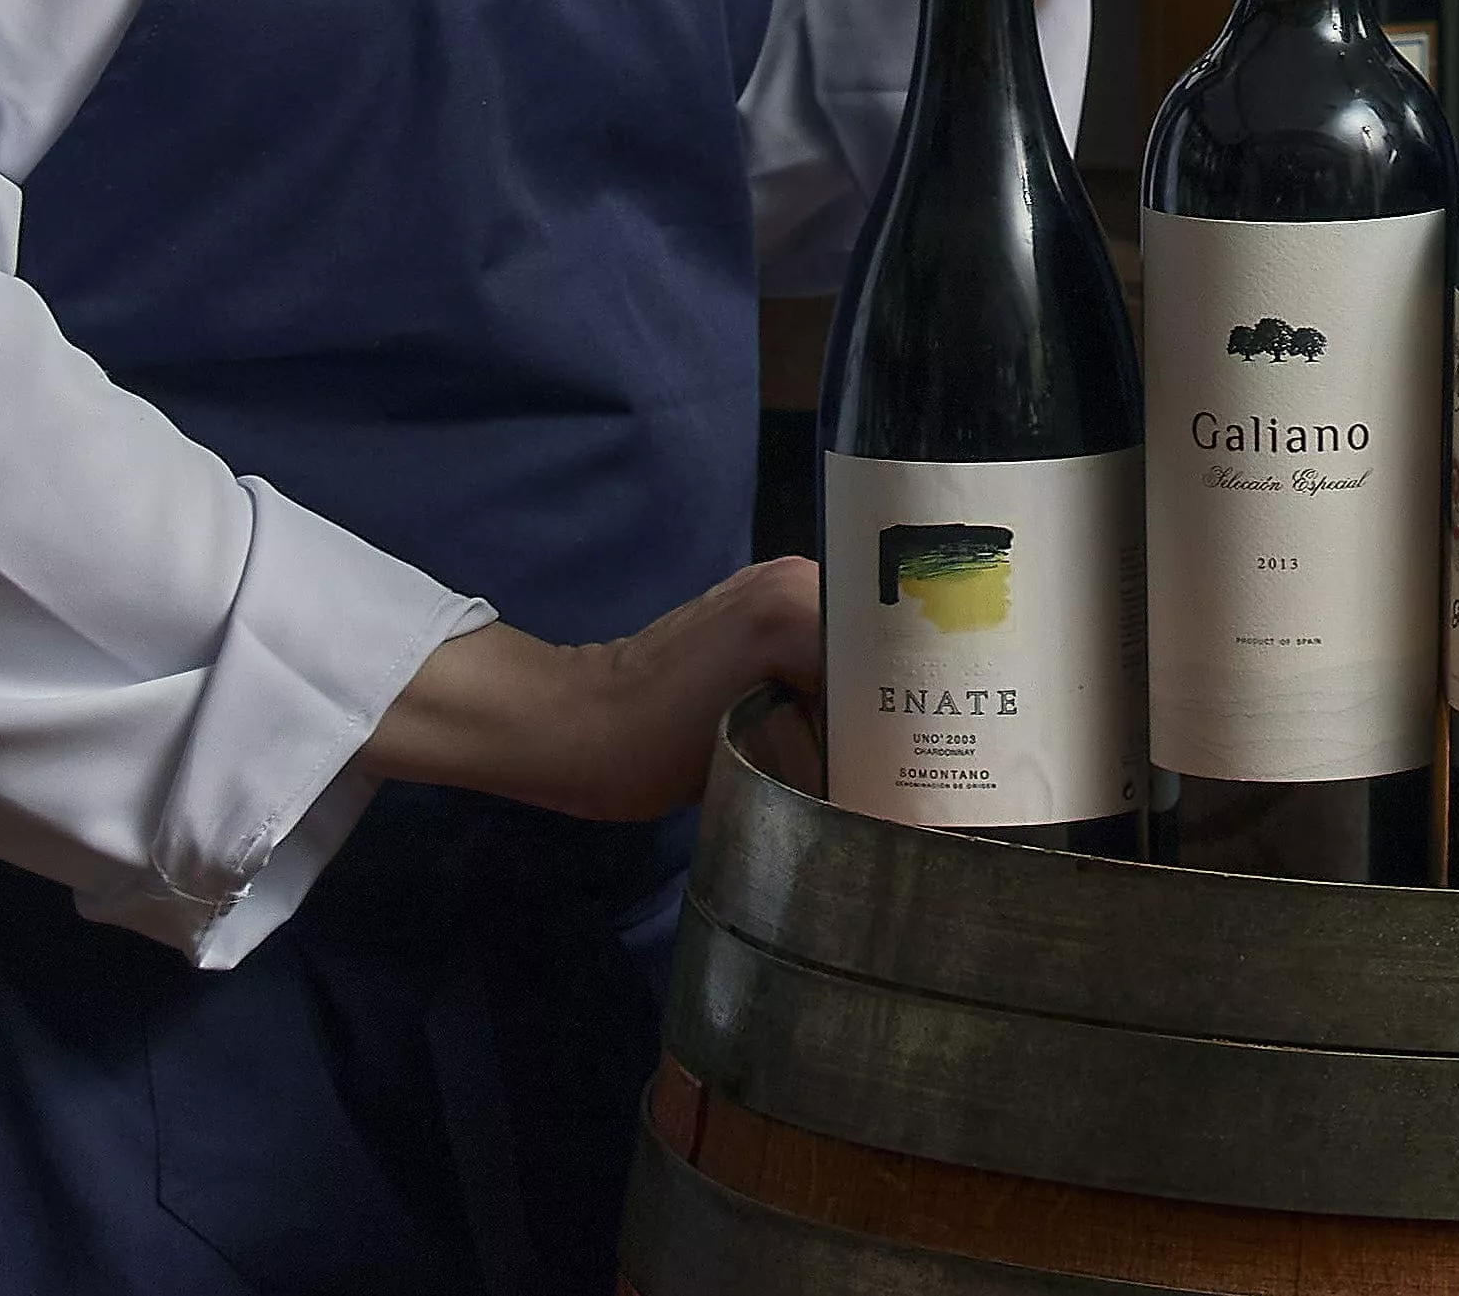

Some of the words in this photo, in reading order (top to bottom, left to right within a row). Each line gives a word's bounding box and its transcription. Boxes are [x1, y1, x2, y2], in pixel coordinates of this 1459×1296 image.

[1192, 411, 1371, 454] Galiano
[1292, 467, 1374, 497] Especial
[1256, 557, 1299, 570] 2013
[1235, 636, 1275, 646] PRODUCT
[1296, 637, 1323, 646] SPAIN
[877, 685, 1020, 716] ENATE
[946, 733, 977, 745] 2003
[898, 767, 991, 781] SOMONTANO
